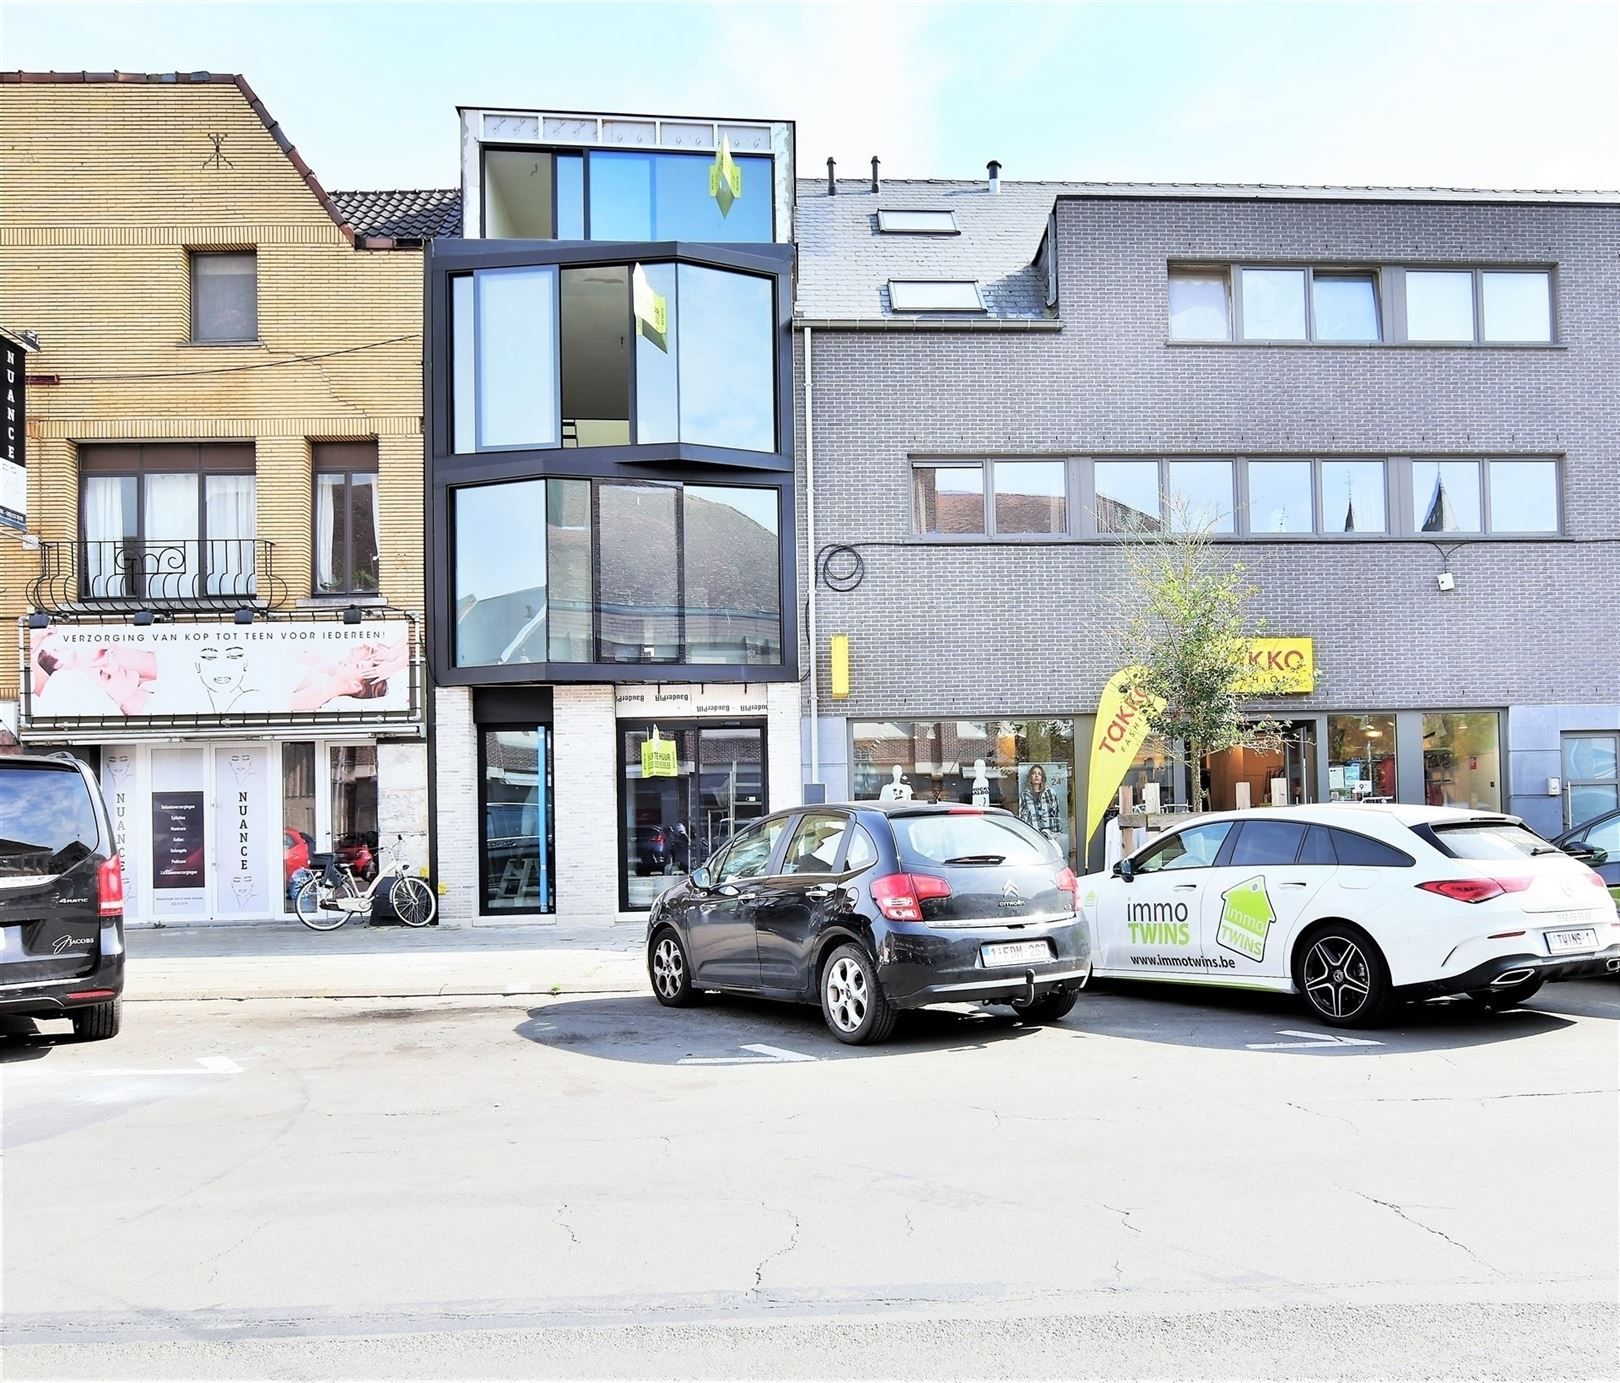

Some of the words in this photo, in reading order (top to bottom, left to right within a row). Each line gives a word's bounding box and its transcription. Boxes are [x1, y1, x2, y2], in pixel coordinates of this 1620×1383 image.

[6, 350, 15, 459] NUANCE
[63, 633, 145, 643] VERZORGING
[152, 632, 178, 642] VAN
[184, 632, 210, 641] KOP
[216, 632, 238, 641] TOT
[245, 632, 274, 640] TEEN
[281, 631, 316, 640] VOOR
[322, 631, 385, 640] IEDEREEN!
[655, 694, 688, 702] BauderPIR
[116, 793, 126, 871] NUANCE
[238, 791, 249, 870] NUANCE
[1127, 897, 1188, 922] immo
[1226, 903, 1265, 933] immo
[1127, 922, 1191, 945] TWINS
[1221, 924, 1263, 956] TWINS
[1130, 954, 1236, 968] www.immotwins.be
